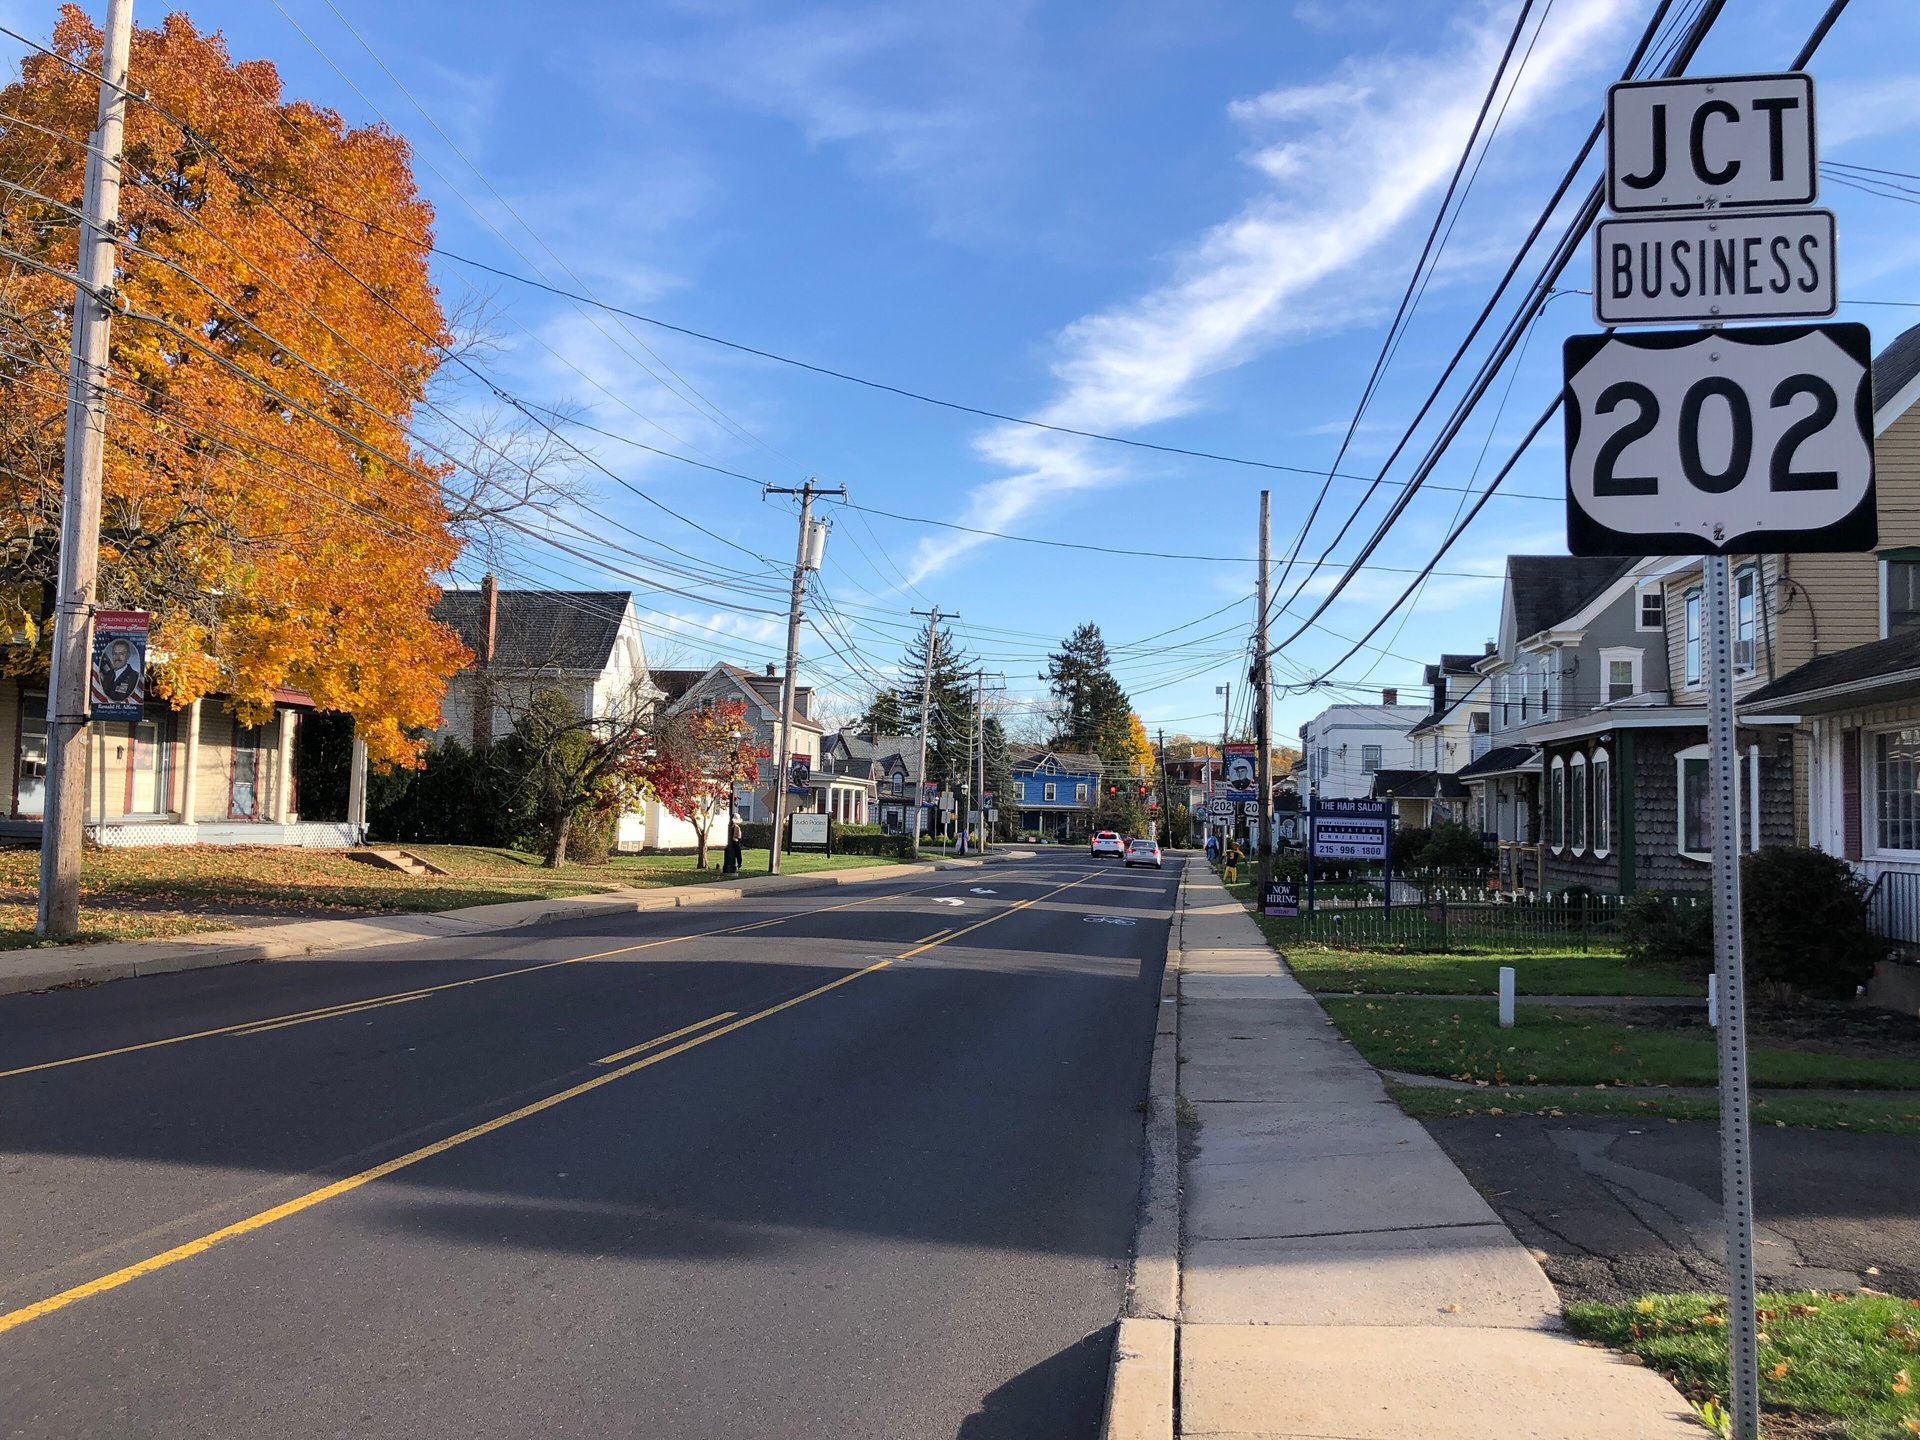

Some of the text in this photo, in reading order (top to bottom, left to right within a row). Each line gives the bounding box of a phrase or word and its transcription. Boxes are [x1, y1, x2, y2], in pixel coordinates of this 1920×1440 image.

[1621, 97, 1799, 190] JCT
[1611, 234, 1819, 299] BUSINESS
[1593, 373, 1839, 497] 202
[1214, 801, 1232, 811] 202
[1245, 803, 1258, 813] 20
[1320, 801, 1383, 812] THE HAIR SALON
[1272, 885, 1291, 895] NOW
[1266, 895, 1297, 904] HIRING
